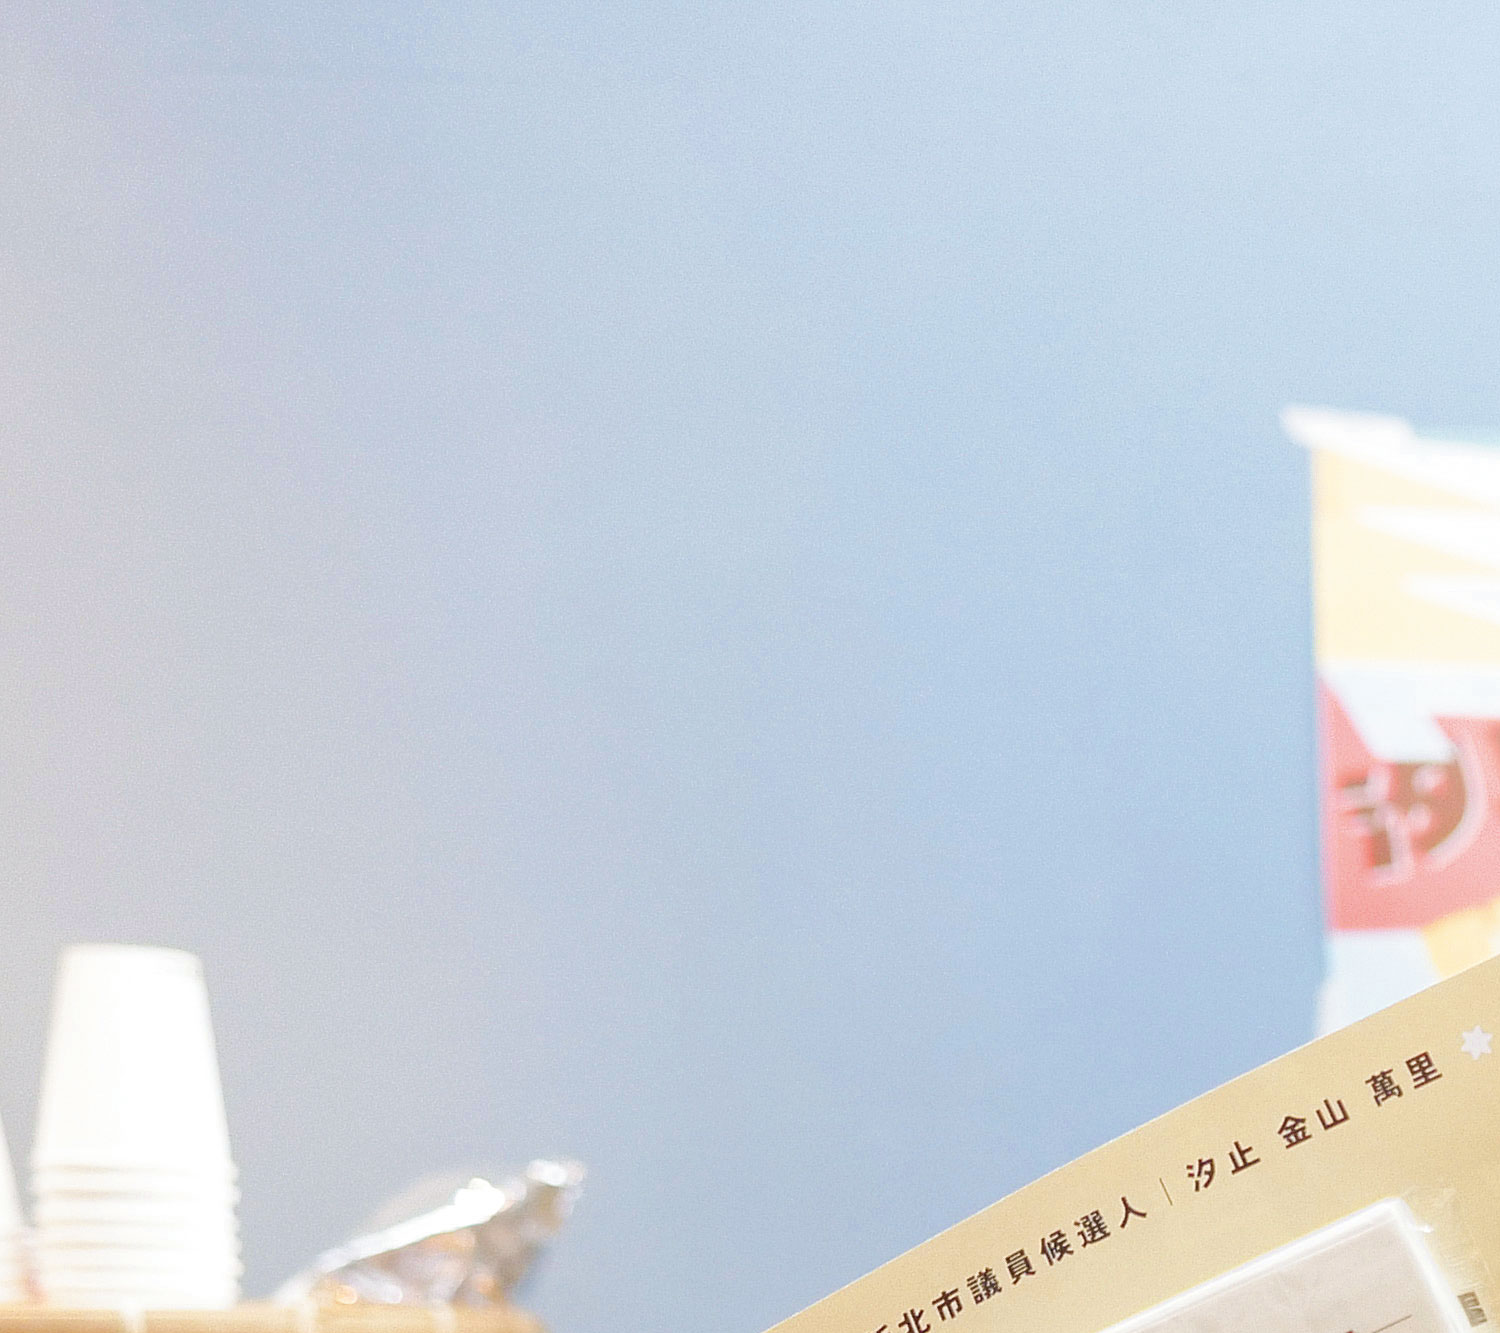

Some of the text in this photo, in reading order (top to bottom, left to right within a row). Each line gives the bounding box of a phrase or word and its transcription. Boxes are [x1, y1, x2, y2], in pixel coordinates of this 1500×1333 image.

[1186, 1140, 1261, 1192] 汐止
[1278, 1098, 1350, 1149] 金山
[1365, 1051, 1443, 1107] 萬里
